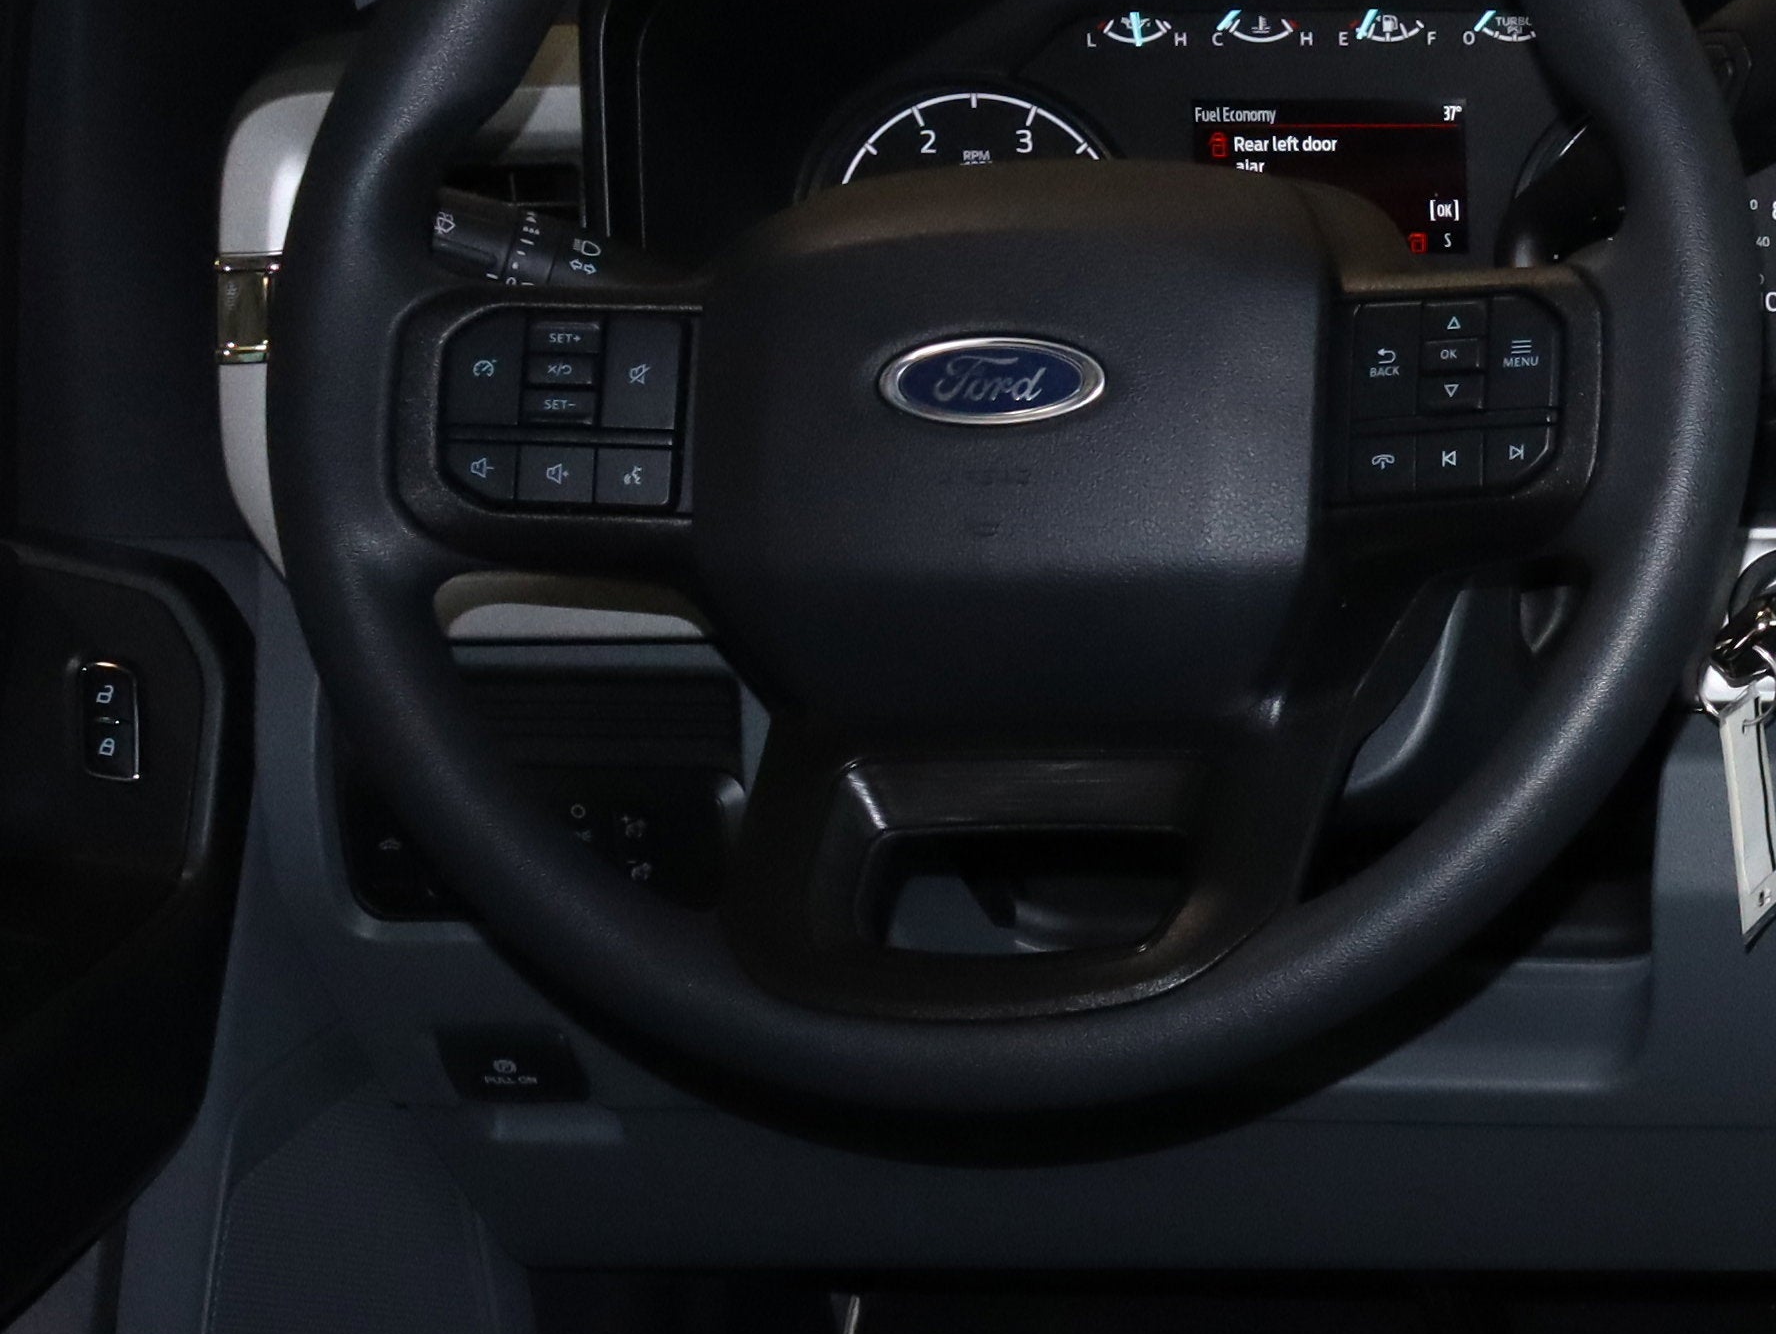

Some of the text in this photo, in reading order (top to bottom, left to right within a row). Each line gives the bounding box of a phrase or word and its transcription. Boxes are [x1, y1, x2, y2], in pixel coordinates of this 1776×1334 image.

[1173, 32, 1188, 47] H
[1211, 31, 1224, 47] C
[1300, 32, 1314, 47] H
[1338, 31, 1349, 47] E
[1426, 31, 1437, 46] F
[1194, 107, 1277, 125] Fuel Economy
[919, 129, 937, 155] 2
[1015, 129, 1034, 154] 3
[1233, 135, 1338, 153] Rear left door
[962, 150, 991, 161] RPM
[1440, 348, 1458, 360] OK
[1502, 356, 1540, 368] MENU
[933, 354, 1047, 402] Ford
[1369, 365, 1400, 378] BACK
